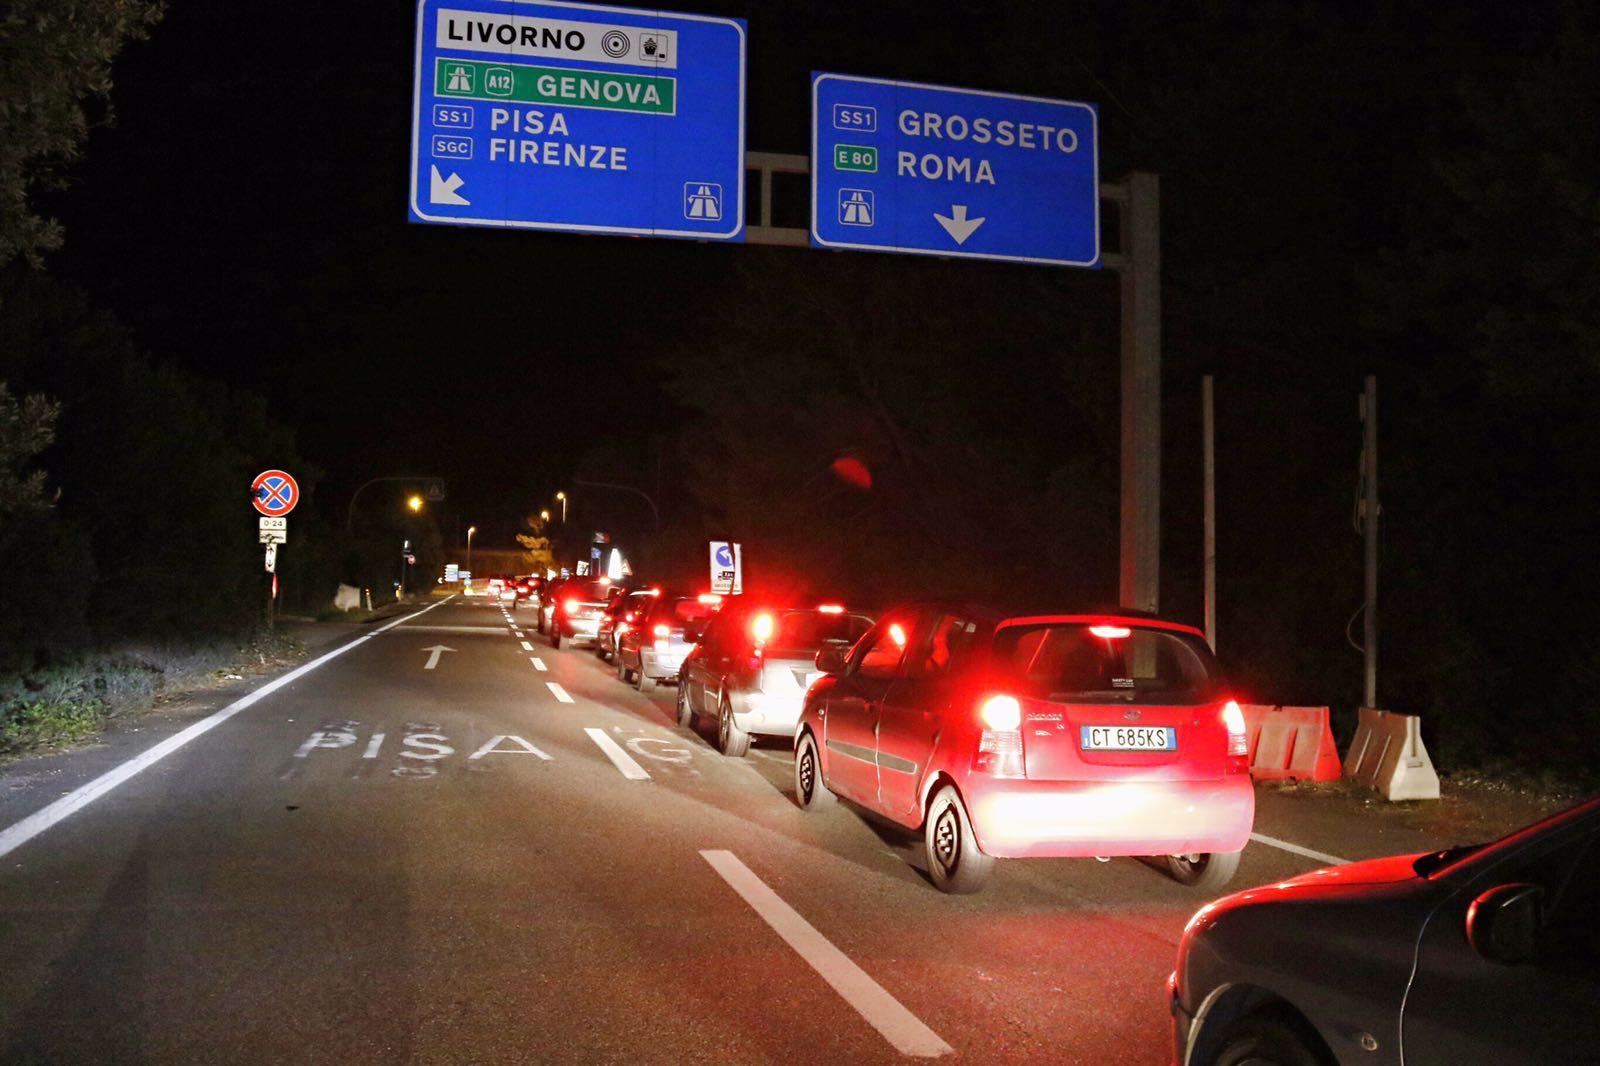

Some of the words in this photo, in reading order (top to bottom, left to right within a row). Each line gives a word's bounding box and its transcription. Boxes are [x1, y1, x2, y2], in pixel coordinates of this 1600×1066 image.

[447, 18, 586, 52] LIVORNO
[488, 75, 511, 90] A12
[536, 74, 662, 106] GENOVA
[438, 110, 469, 124] SS1
[490, 107, 570, 137] PISA
[840, 110, 872, 127] SS1
[898, 109, 1079, 154] GROSSETO
[436, 140, 469, 154] SGC
[488, 138, 628, 171] FIRENZE
[839, 152, 848, 164] E
[852, 153, 873, 166] 80
[897, 150, 996, 185] ROMA
[293, 732, 554, 761] PISA
[1092, 728, 1110, 746] CT
[1116, 729, 1165, 747] 685KS
